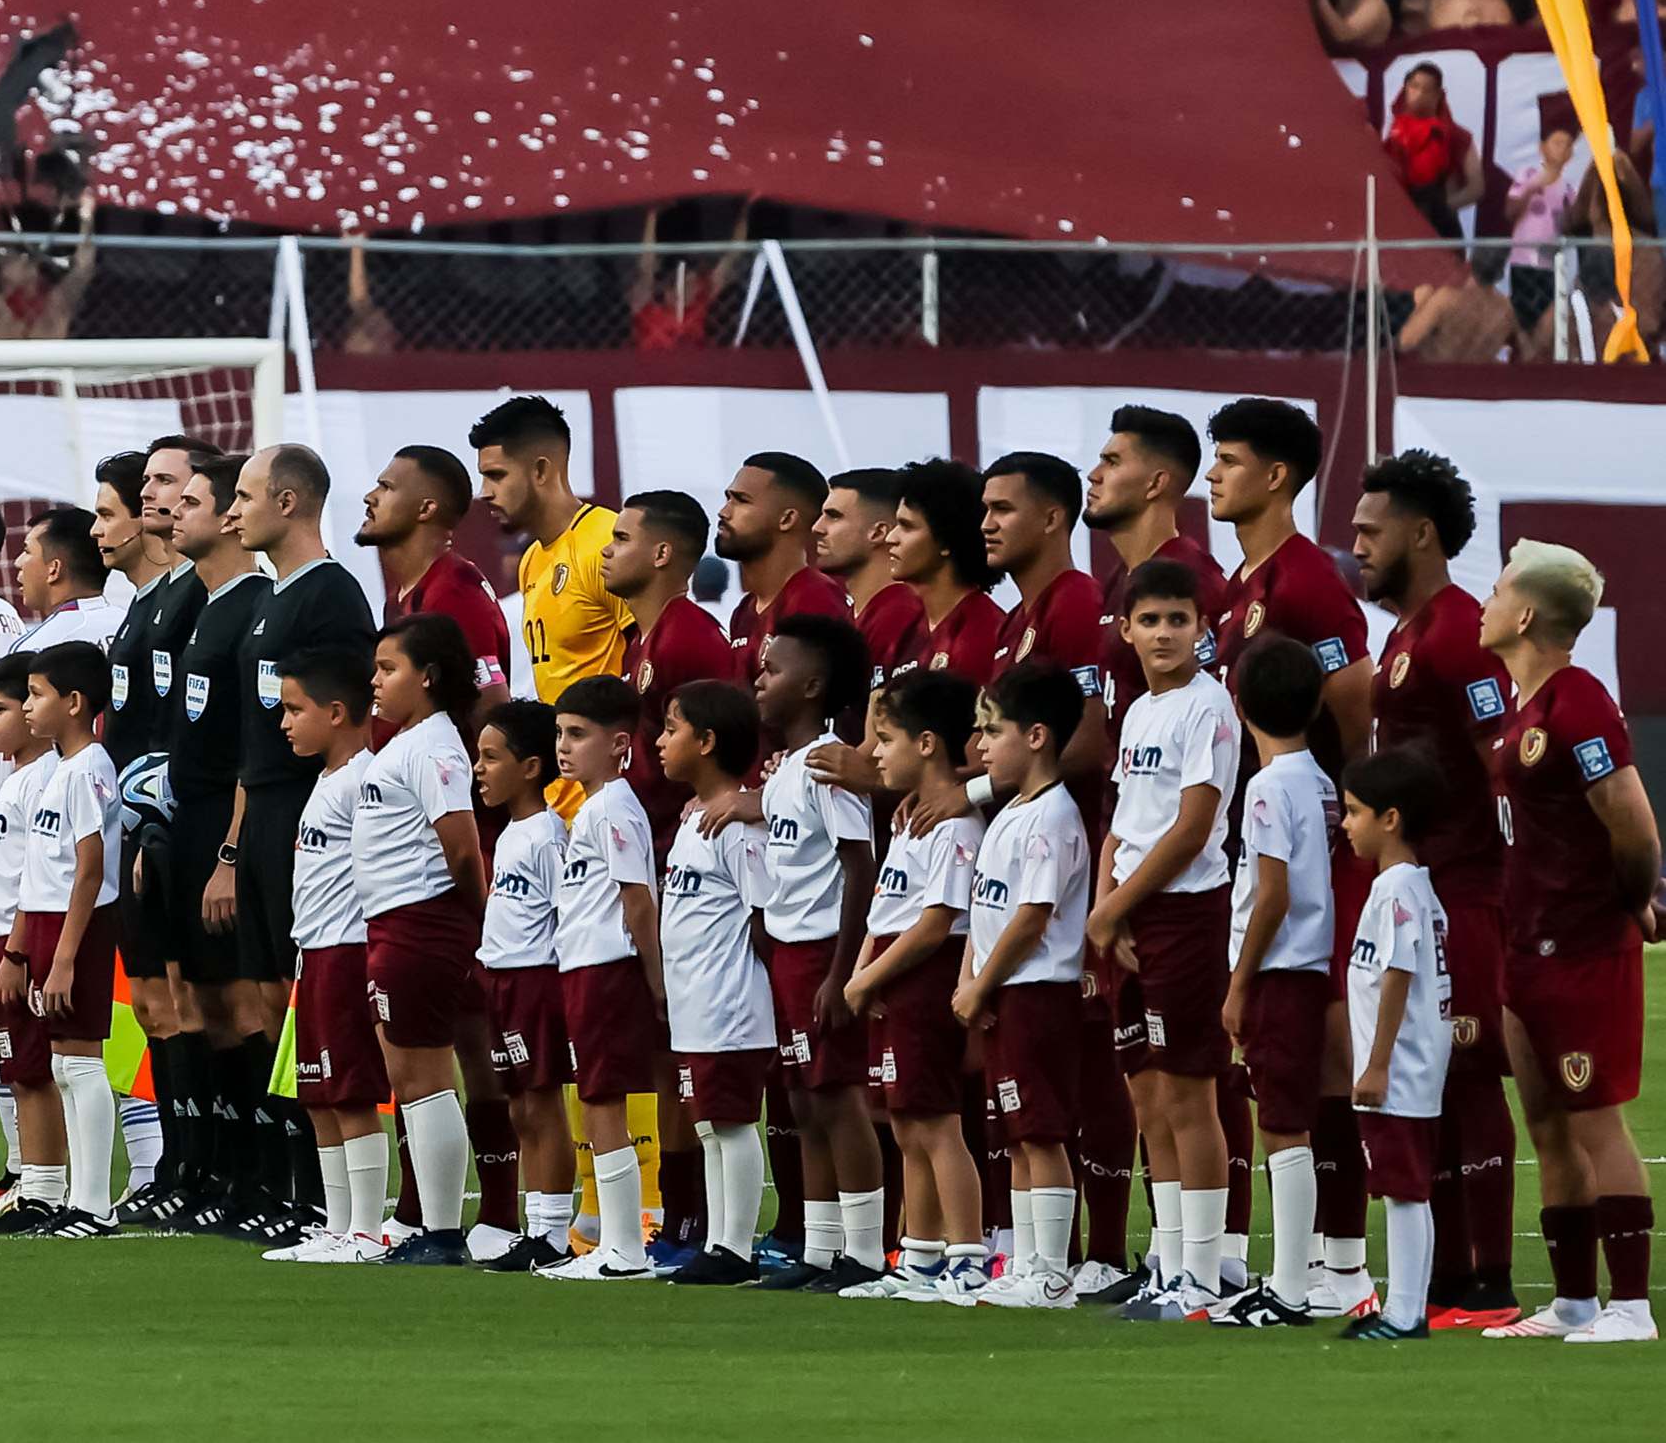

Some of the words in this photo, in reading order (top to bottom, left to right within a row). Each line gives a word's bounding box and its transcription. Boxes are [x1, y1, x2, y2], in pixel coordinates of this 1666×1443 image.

[153, 653, 170, 666] FIFA
[112, 667, 127, 681] FIFA
[260, 663, 278, 676] FIF
[188, 677, 206, 692] FIFA
